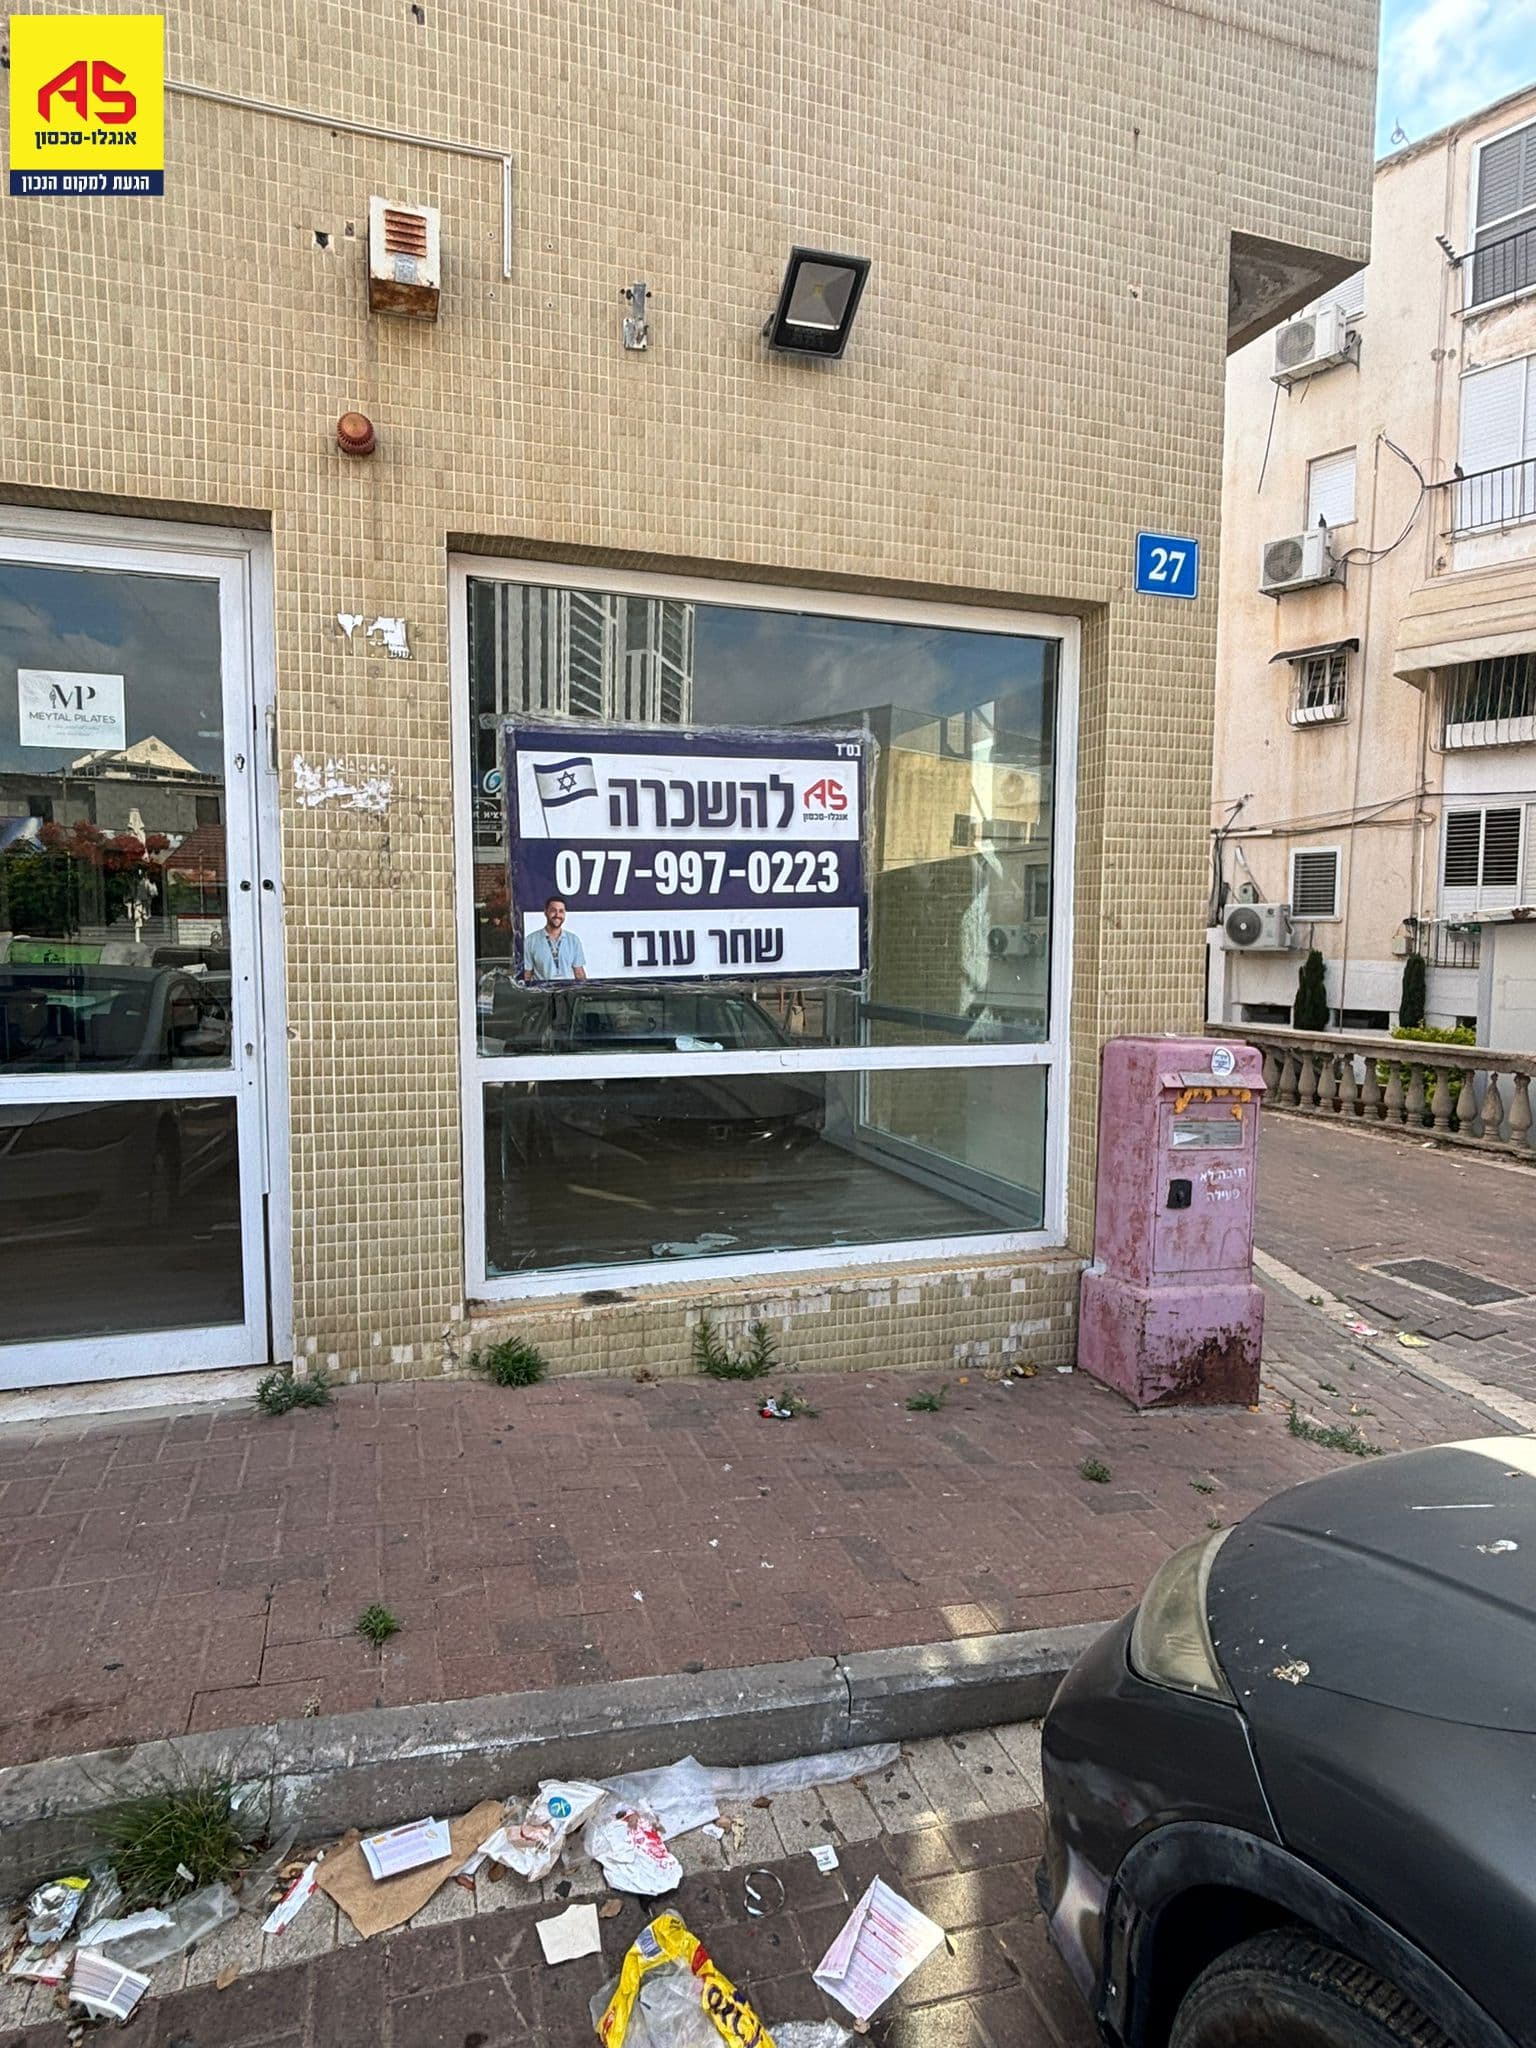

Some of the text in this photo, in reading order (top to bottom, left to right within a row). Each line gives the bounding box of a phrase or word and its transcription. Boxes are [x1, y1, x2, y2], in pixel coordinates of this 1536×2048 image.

[1148, 547, 1187, 584] 27
[49, 683, 96, 710] MP
[29, 711, 117, 724] MEYTAL PILATES
[607, 774, 795, 829] להשכרה
[804, 778, 848, 811] AS
[802, 812, 849, 823] אנגלו-סכסון
[555, 850, 840, 896] 077-997-0223
[612, 928, 784, 967] שחר עובד
